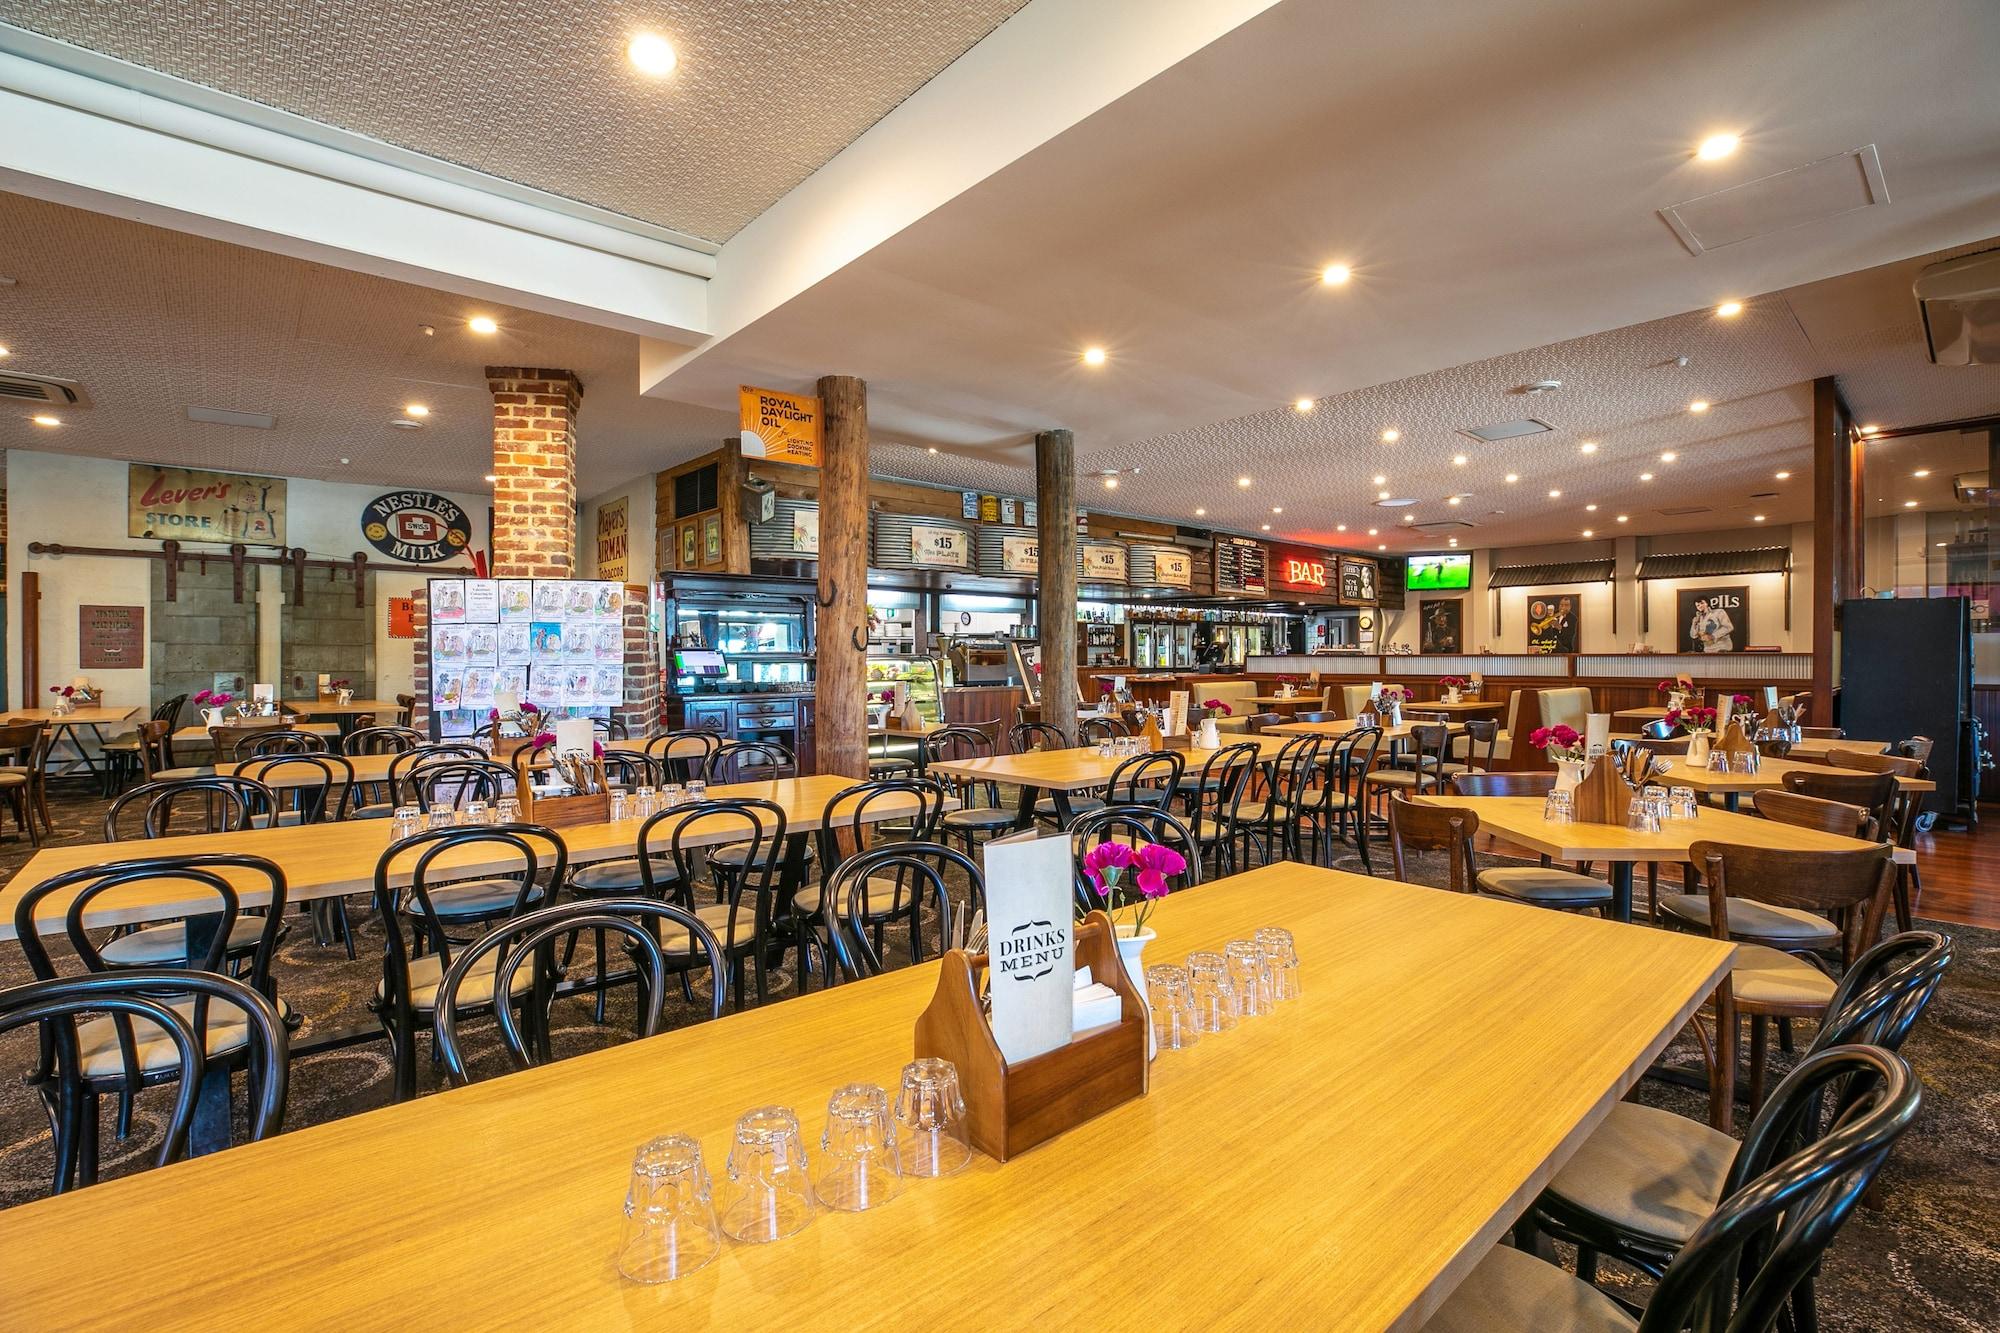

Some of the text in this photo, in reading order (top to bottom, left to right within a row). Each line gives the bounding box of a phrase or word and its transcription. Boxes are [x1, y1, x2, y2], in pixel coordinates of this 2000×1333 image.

[760, 396, 800, 411] ROYAL
[761, 406, 813, 423] DAYLIGHT
[761, 417, 781, 428] OIL
[787, 438, 814, 447] LIGHTING
[787, 443, 813, 452] COOKING
[787, 449, 813, 457] HEATING
[141, 473, 231, 507] Lever's
[145, 512, 211, 528] STORE
[407, 522, 429, 531] SWISS
[598, 505, 625, 537] Player's
[934, 537, 952, 549] $15
[390, 541, 446, 561] MILK
[1024, 546, 1040, 558] $15
[1101, 554, 1114, 564] $15
[598, 565, 624, 580] Tobaccos
[1170, 562, 1183, 572] $15
[1288, 559, 1326, 587] BAR
[999, 928, 1065, 957] DRINKS
[999, 947, 1065, 973] MENU
